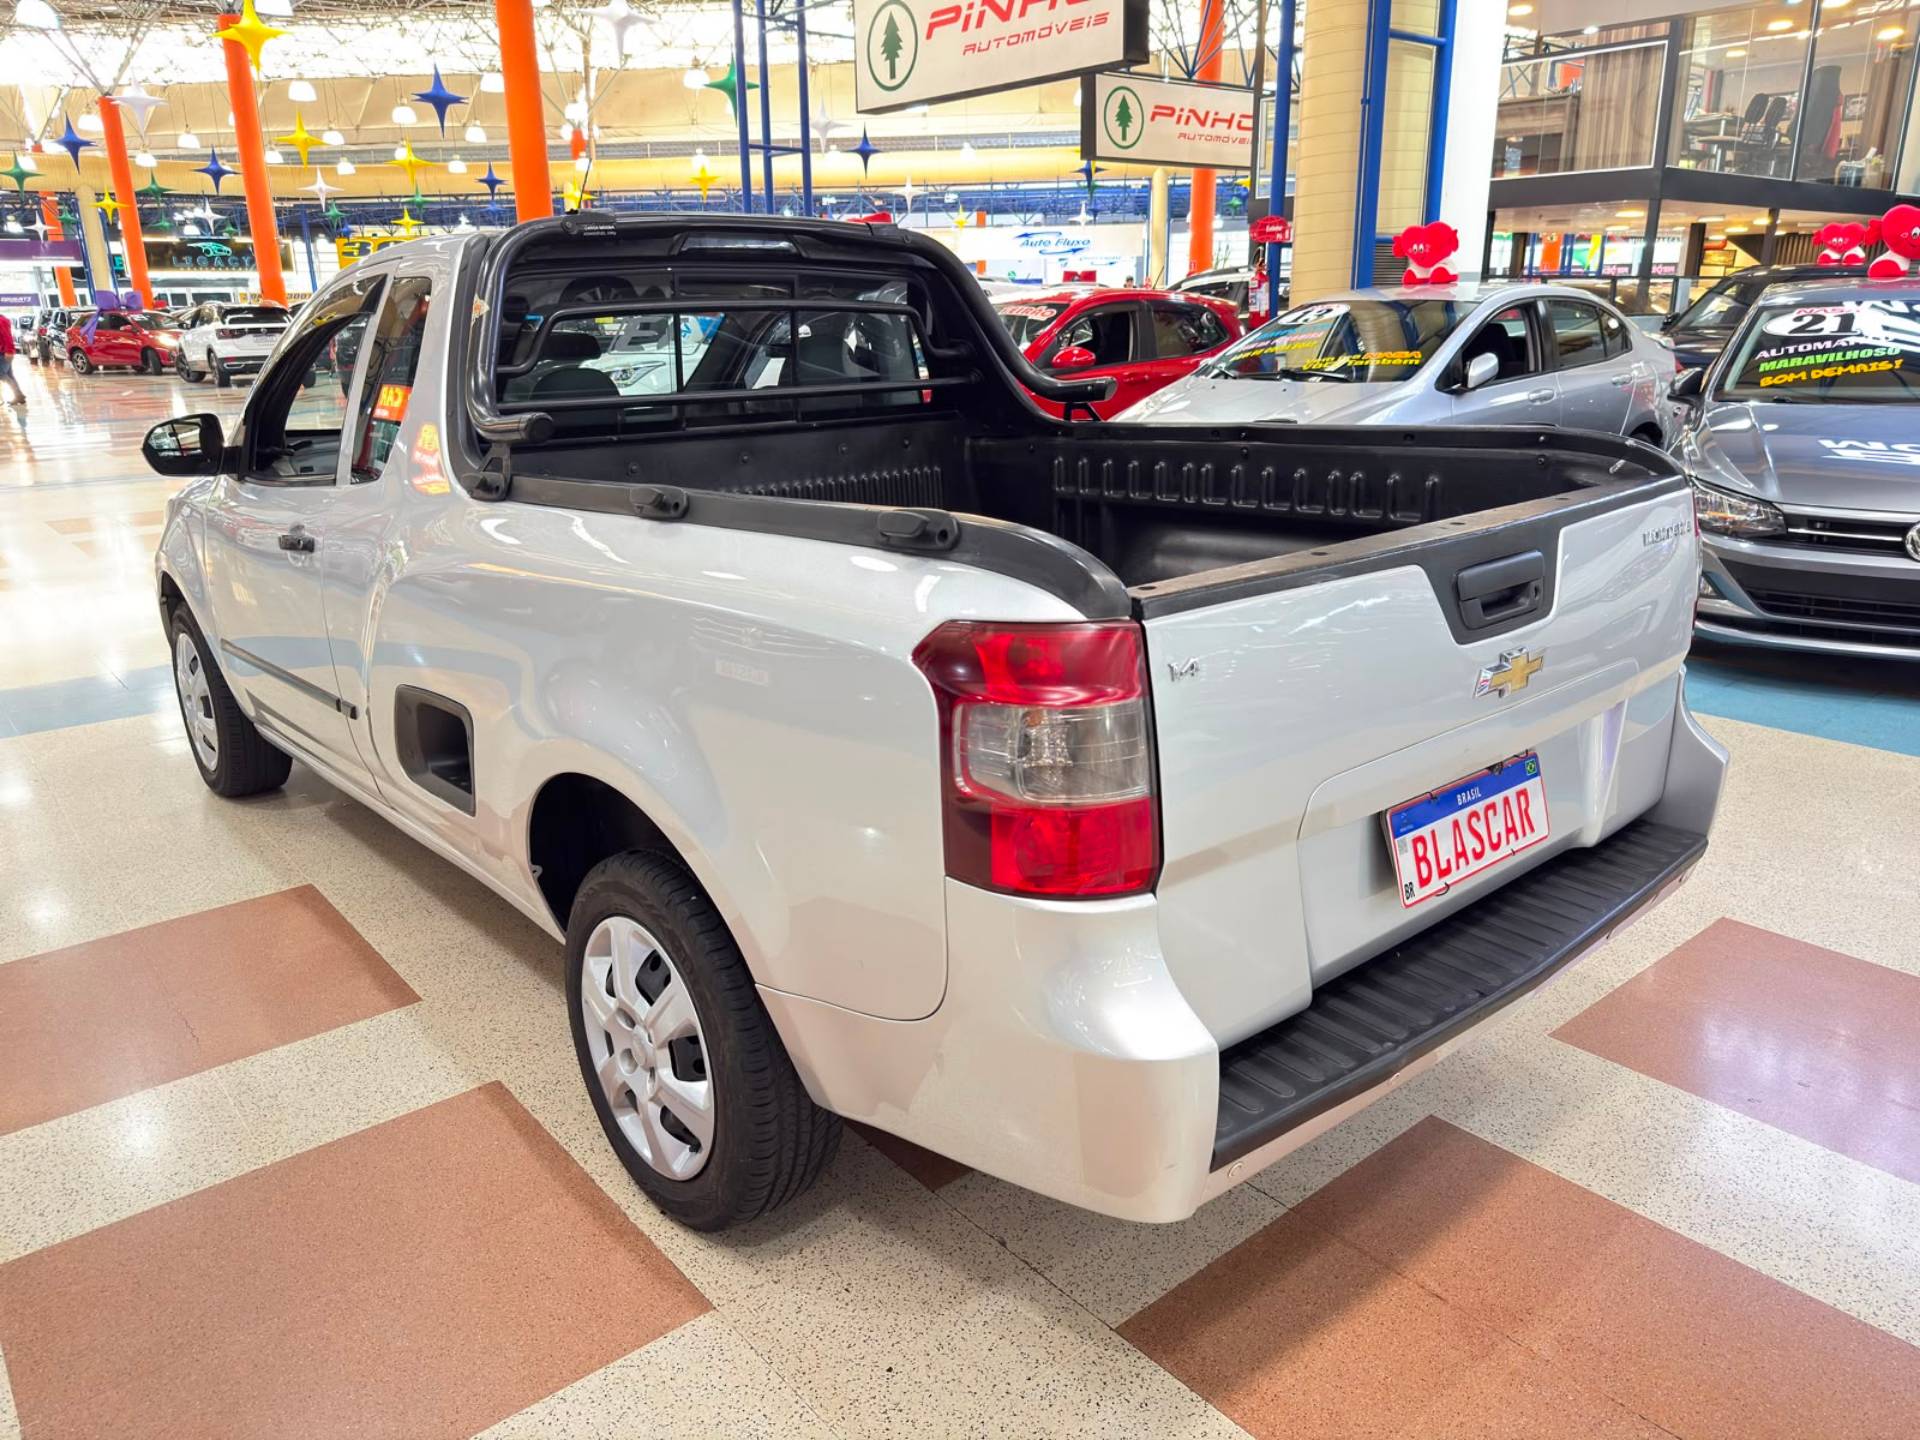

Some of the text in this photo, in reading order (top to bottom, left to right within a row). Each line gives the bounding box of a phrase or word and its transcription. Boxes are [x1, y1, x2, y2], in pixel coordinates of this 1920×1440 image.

[172, 255, 253, 267] LEGACY
[1788, 313, 1862, 335] 21
[1759, 347, 1900, 372] MARAVILHOSO
[1760, 371, 1807, 387] BOM
[1456, 787, 1482, 806] BRASIL
[1411, 788, 1535, 889] BLASCAR
[1404, 881, 1415, 900] BR
